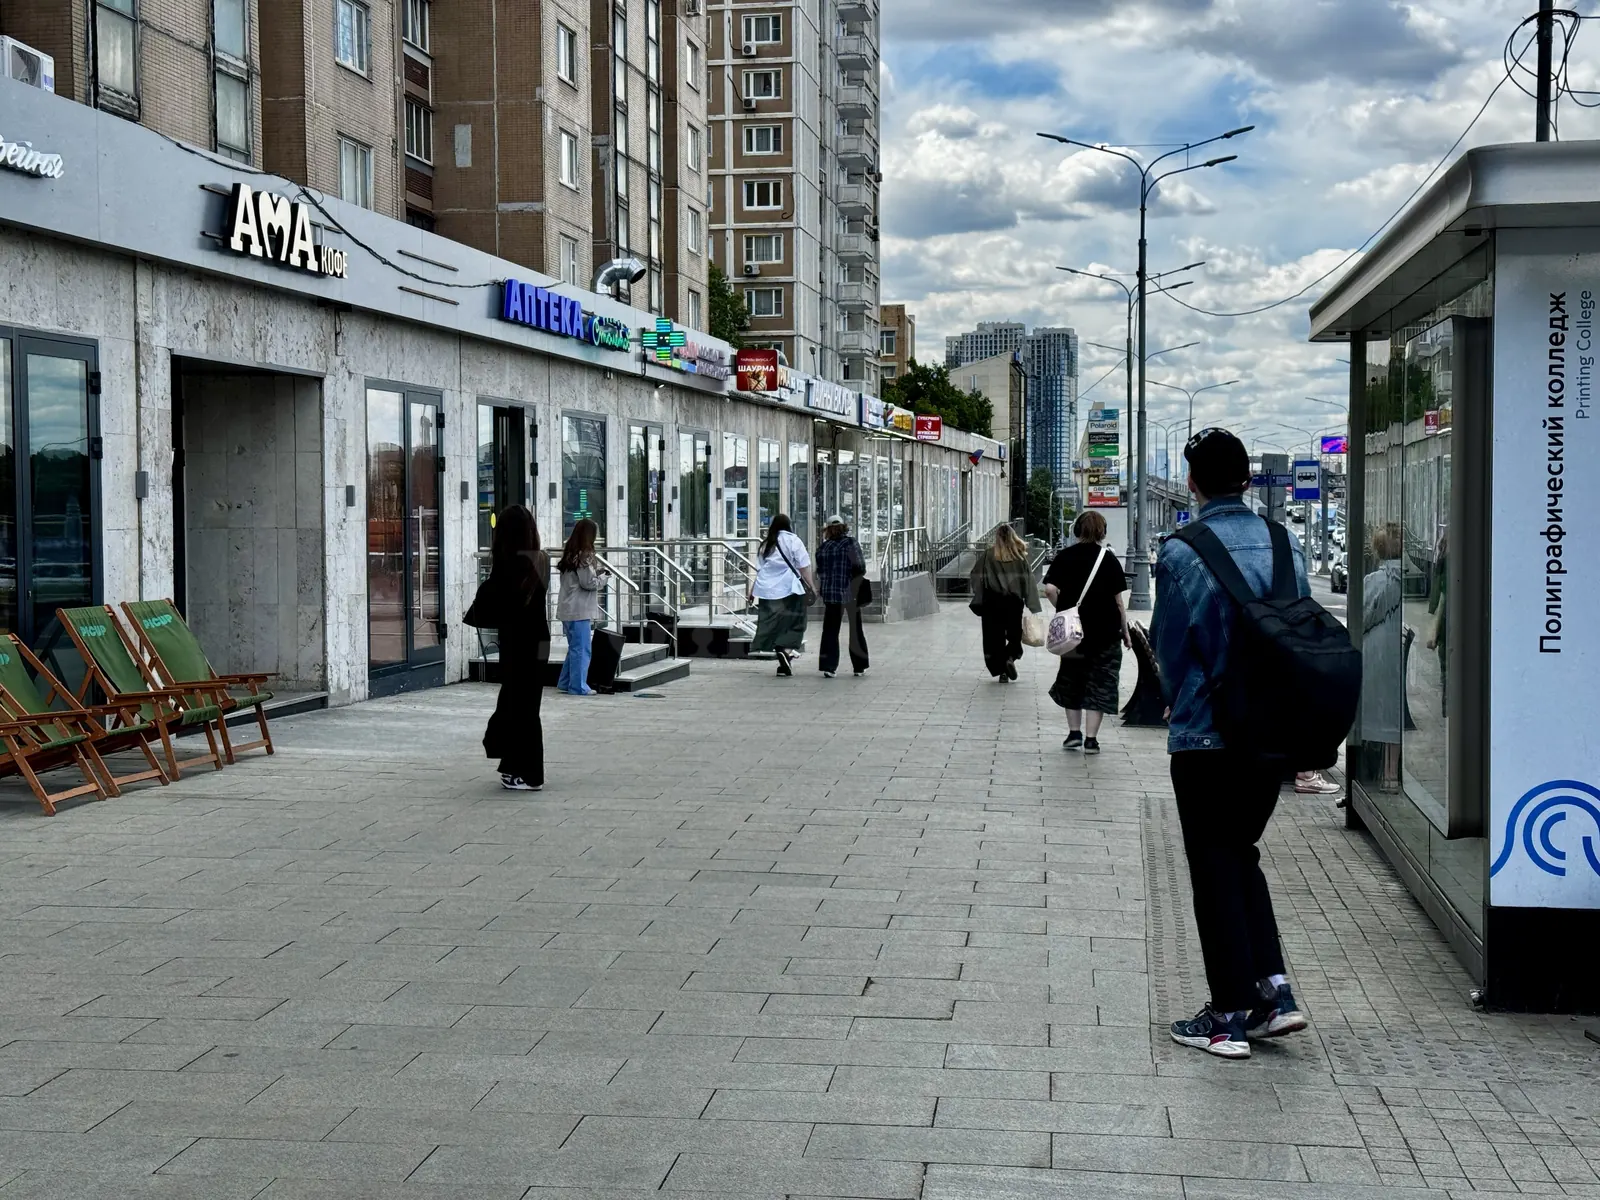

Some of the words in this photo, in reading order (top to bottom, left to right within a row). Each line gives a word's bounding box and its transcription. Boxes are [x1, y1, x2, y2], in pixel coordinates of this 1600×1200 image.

[320, 246, 348, 280] КОФЕ
[506, 279, 584, 340] АПТЕКА
[1576, 290, 1596, 351] College
[738, 365, 775, 373] ШАУРМА
[1547, 291, 1569, 408] колледж
[1575, 355, 1595, 419] Printing
[1090, 421, 1117, 429] Polaroid
[1539, 416, 1568, 653] Полиграфический
[80, 625, 107, 637] PICUP
[143, 614, 173, 629] PICUP
